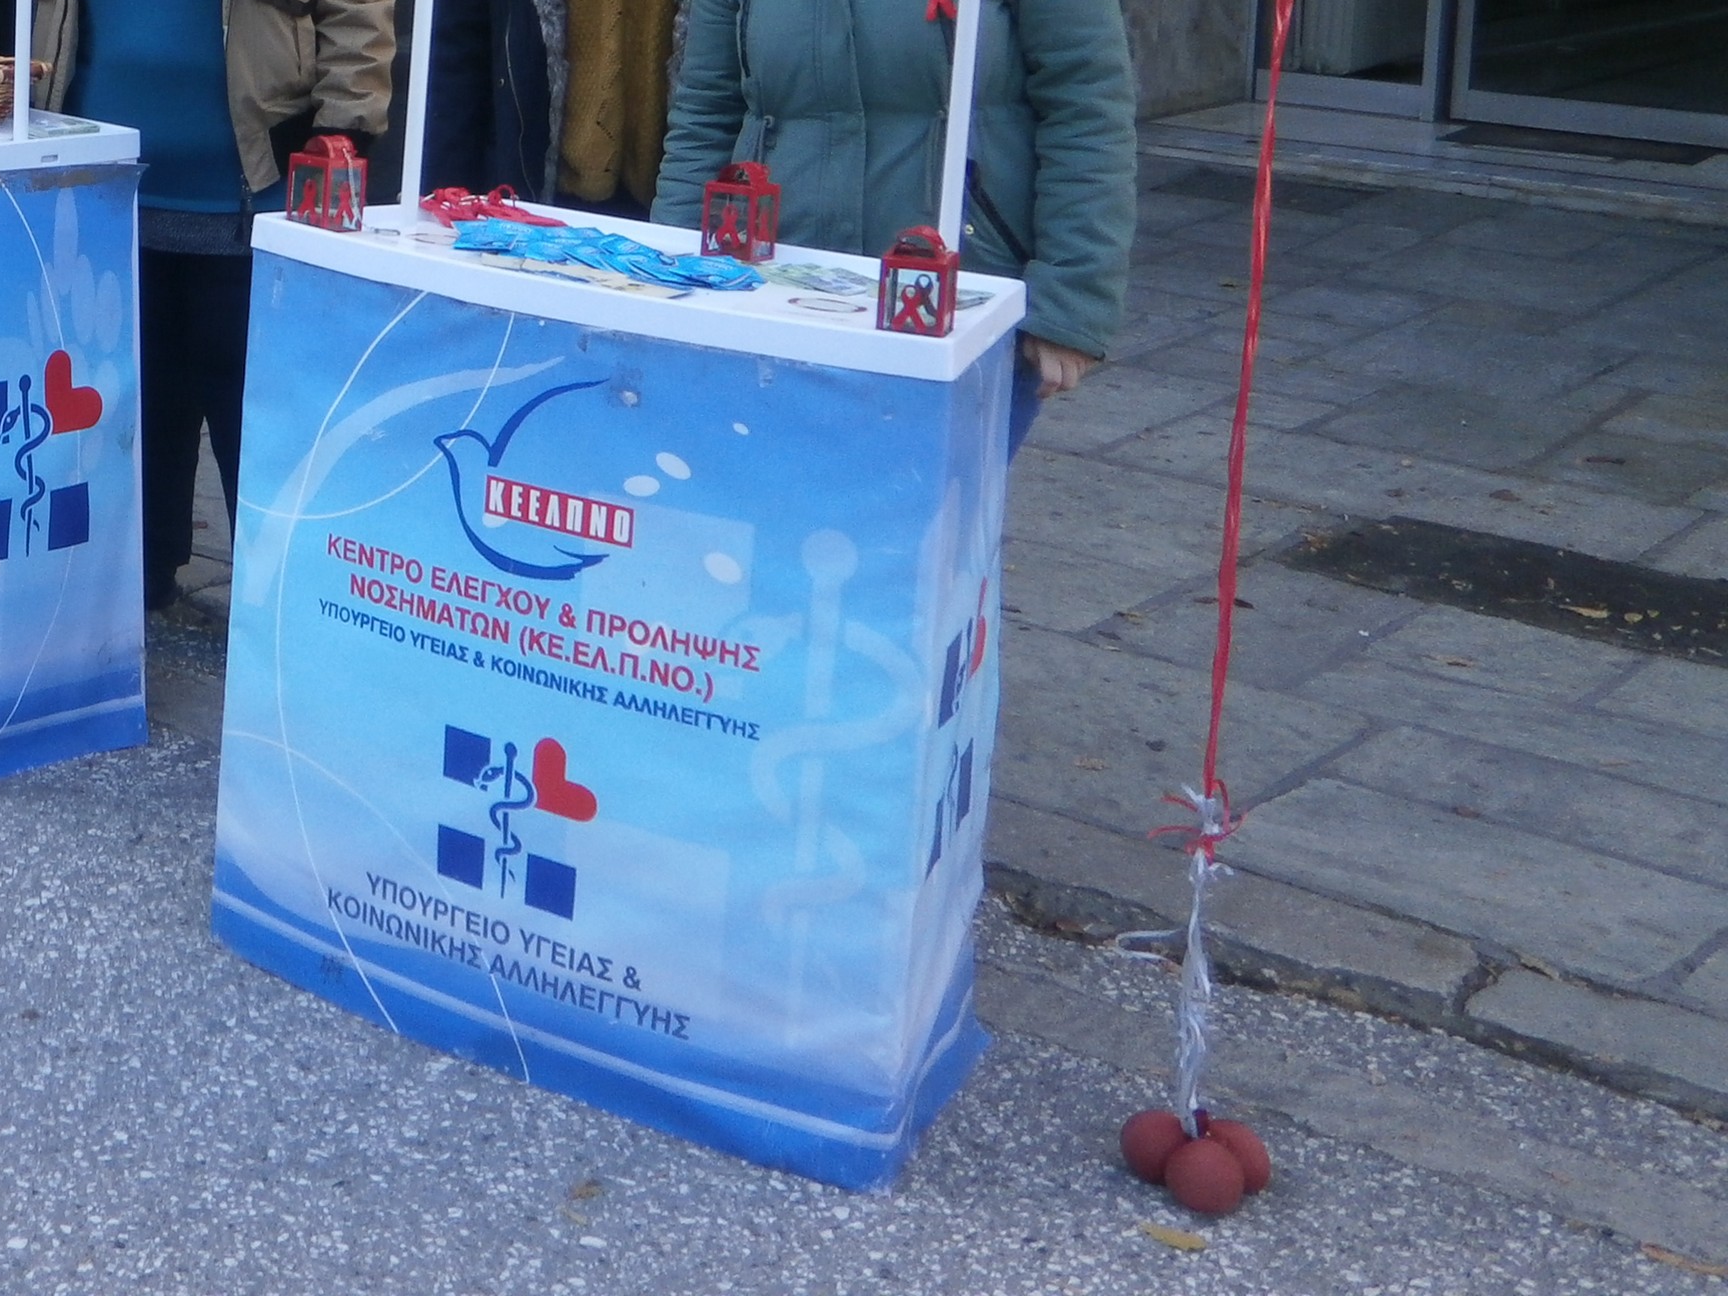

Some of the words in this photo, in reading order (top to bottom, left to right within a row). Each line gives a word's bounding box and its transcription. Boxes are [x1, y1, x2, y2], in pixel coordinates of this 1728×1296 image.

[488, 479, 632, 544] ΚΕΕΛΠΝΟ
[319, 598, 406, 643] ΥΠΟΥΡΓΕΙΟ
[410, 630, 469, 664] ΥΓΕΙΑΣ
[473, 651, 485, 669] &
[490, 654, 608, 705] ΚΟΙΝΩΝΙΚΗΣ
[613, 691, 761, 741] ΑΛΛΗΛΕΓΓΥΗΣ
[327, 533, 423, 583] ΚΕΝΤΡΟ
[431, 564, 551, 619] ΕΛΕΓΧΟΥ
[558, 603, 577, 629] &
[587, 609, 761, 674] ΠΡΟΛΗΨΗΣ
[350, 573, 510, 645] ΝΟΣΗΜΑΤΩΝ
[519, 625, 715, 703] (ΚΕ.ΕΛ.Π.ΝΟ.)
[327, 887, 483, 971] ΚΟΙΝΩΝΙΚΗΣ
[489, 955, 691, 1041] ΑΛΛΗΛΕΓΓΥΗΣ
[366, 871, 510, 945] ΥΠΟΥΡΓΕΙΟ
[520, 929, 614, 981] ΥΓΕΙΑΣ
[623, 966, 642, 992] &
